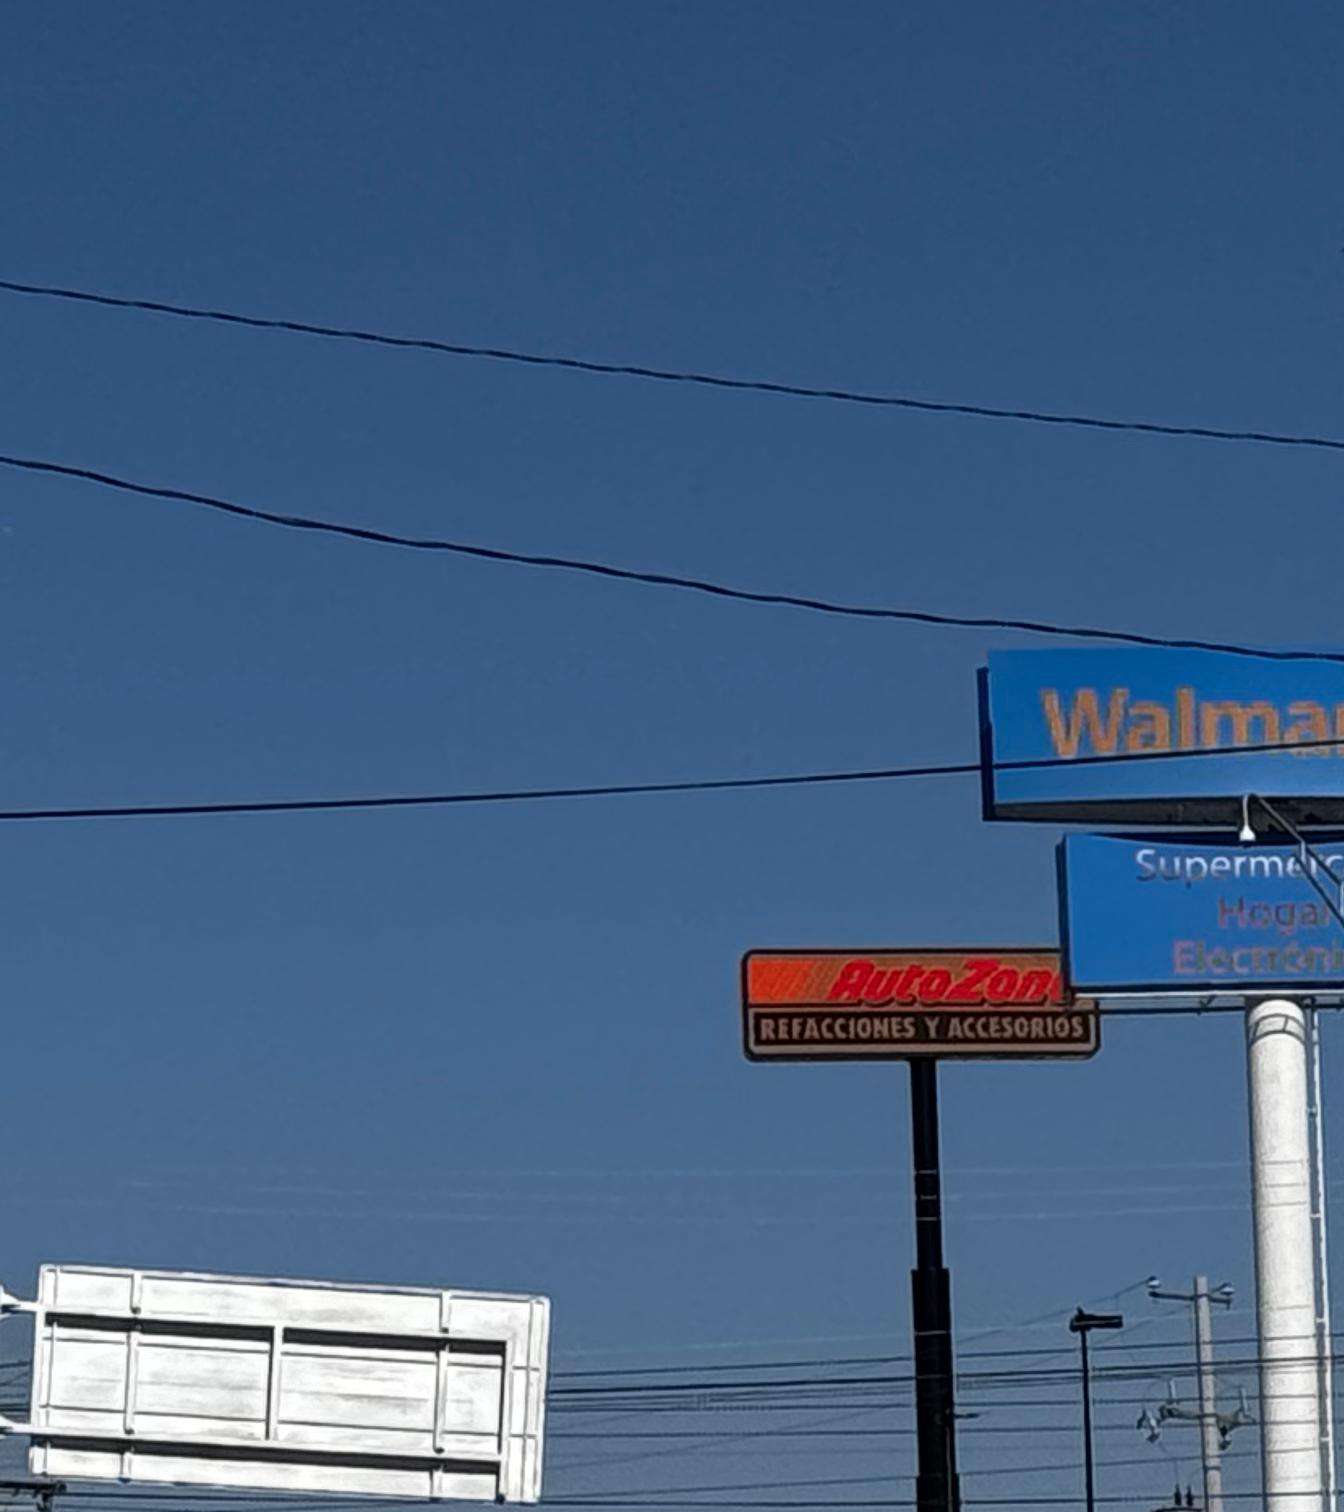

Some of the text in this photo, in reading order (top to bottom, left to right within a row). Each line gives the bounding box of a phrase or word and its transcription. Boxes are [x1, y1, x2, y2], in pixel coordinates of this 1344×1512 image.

[759, 1015, 1084, 1041] REFACCIONES Y ACCESORIOS
